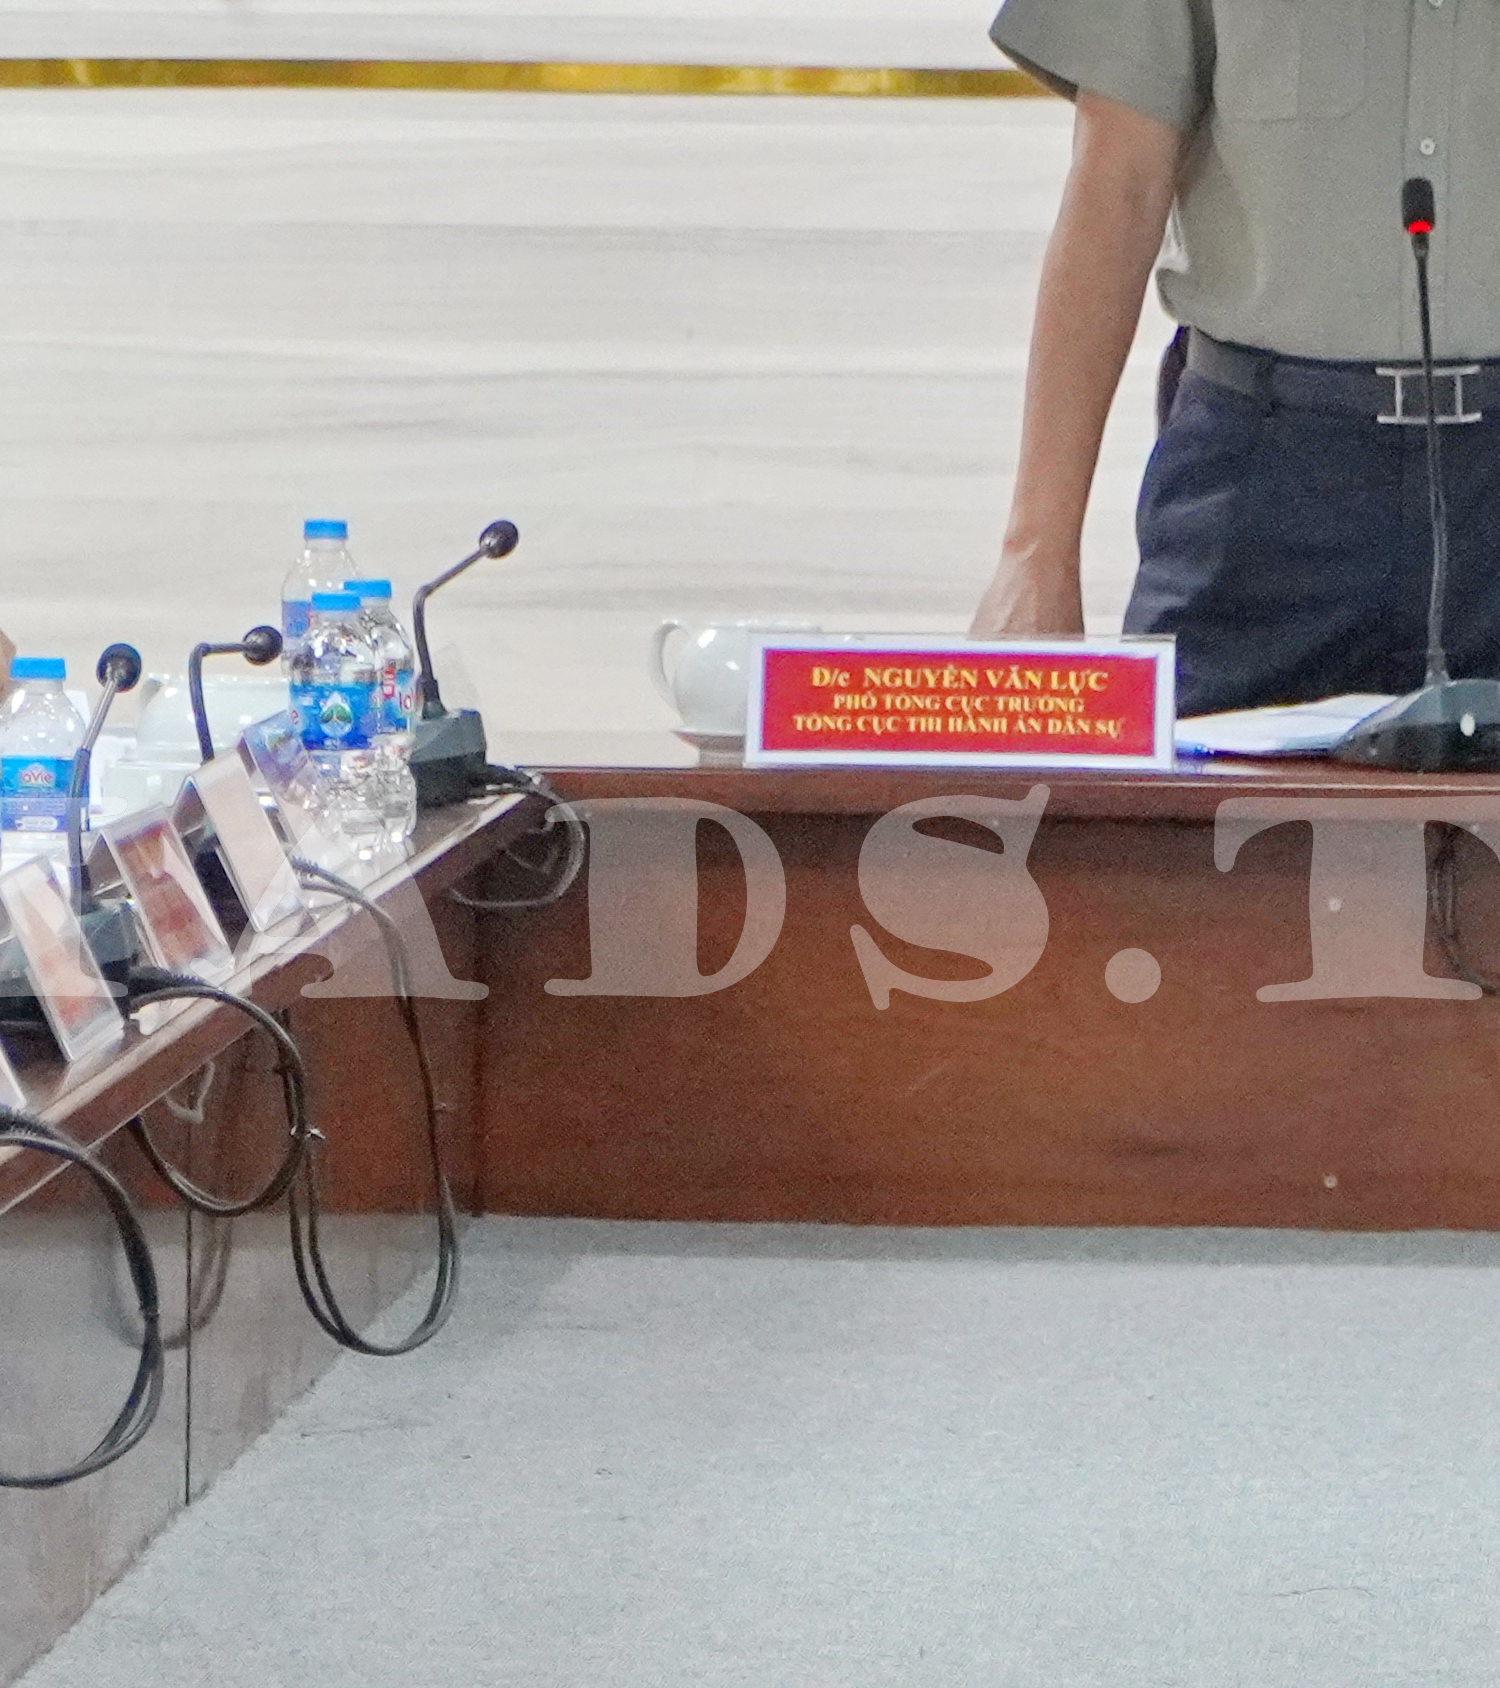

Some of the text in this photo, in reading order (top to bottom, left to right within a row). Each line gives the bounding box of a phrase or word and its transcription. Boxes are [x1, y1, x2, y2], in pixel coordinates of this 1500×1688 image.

[985, 664, 1043, 690] VĂN
[944, 695, 990, 715] CỤC
[856, 716, 901, 736] CỤC
[907, 717, 942, 733] THI
[948, 713, 1007, 734] HÀNH
